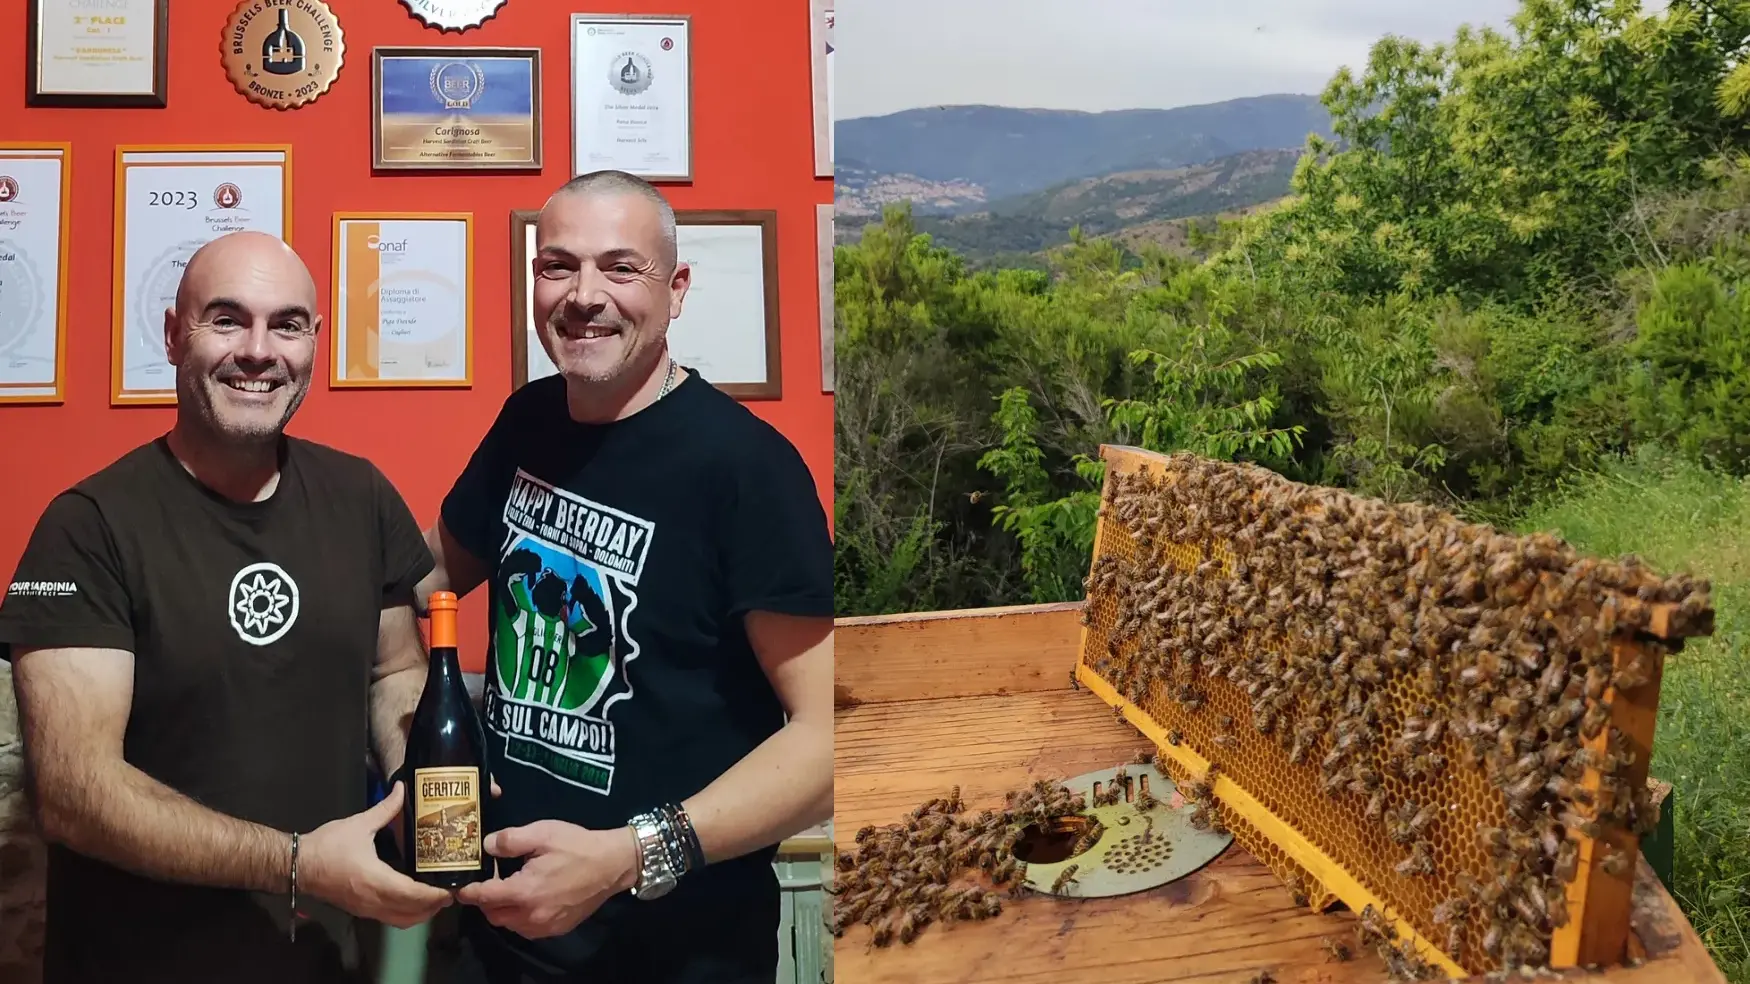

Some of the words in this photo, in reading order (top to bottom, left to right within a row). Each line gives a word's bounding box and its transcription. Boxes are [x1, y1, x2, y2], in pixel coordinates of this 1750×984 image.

[91, 16, 126, 25] PLACE
[233, 3, 262, 54] BRUSSELS
[296, 0, 333, 53] CHALLENGE
[248, 80, 285, 100] BRONZE
[295, 80, 319, 98] 2023
[435, 127, 480, 138] Carignosa
[149, 191, 198, 210] 2023
[379, 239, 408, 251] onaf
[172, 260, 187, 268] The
[381, 288, 411, 296] Diploma
[512, 477, 554, 522] HAPPY
[554, 498, 645, 558] BEERDAY
[560, 532, 569, 545] DI
[593, 547, 635, 573] DOLOMITI
[527, 645, 560, 688] 08
[502, 703, 534, 735] SUL
[539, 711, 607, 753] CAMPO!
[422, 781, 470, 797] GERATZIA
